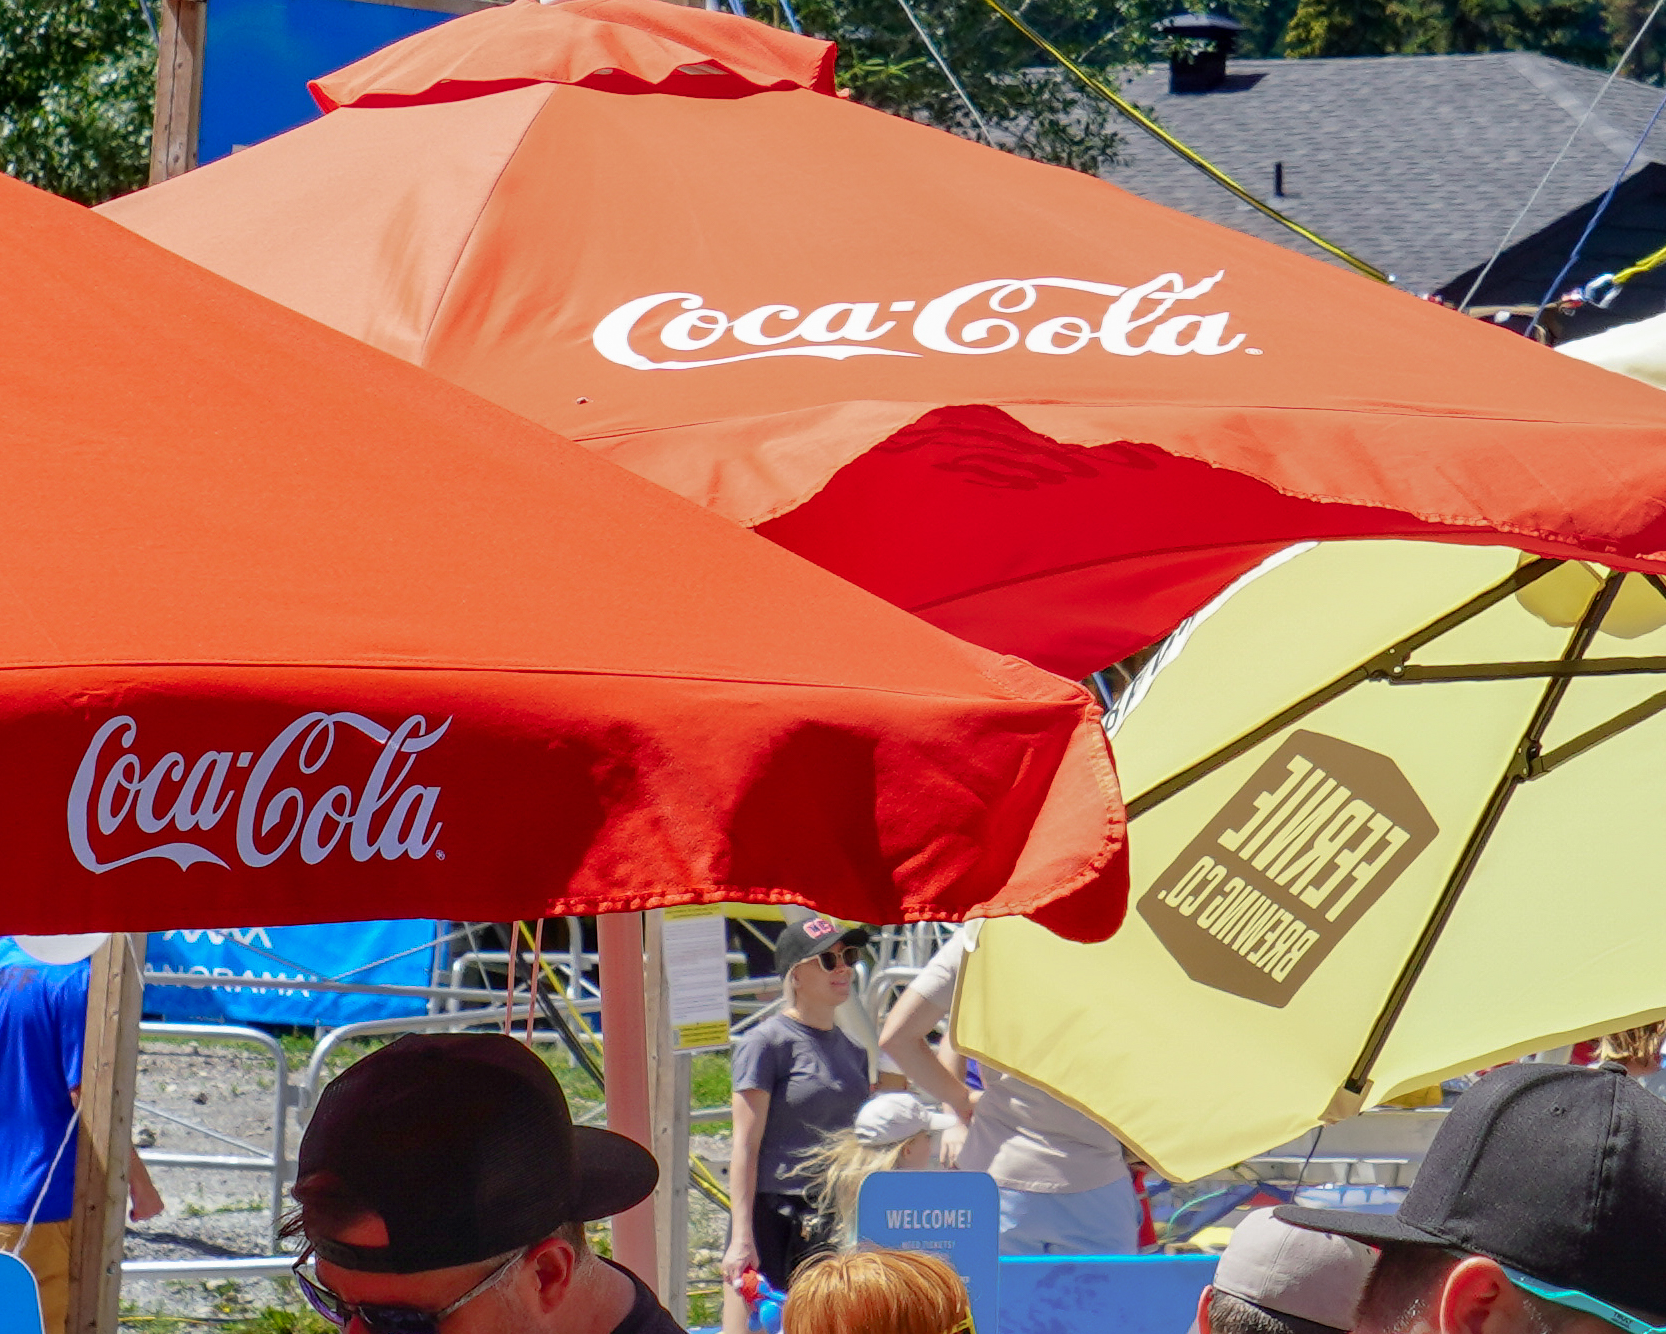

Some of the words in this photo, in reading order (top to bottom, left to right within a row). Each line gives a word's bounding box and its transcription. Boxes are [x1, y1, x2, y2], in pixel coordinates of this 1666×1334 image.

[592, 269, 1247, 371] Coca-Cola
[67, 712, 452, 873] Coca-Cola
[886, 1209, 972, 1229] WELCOME!
